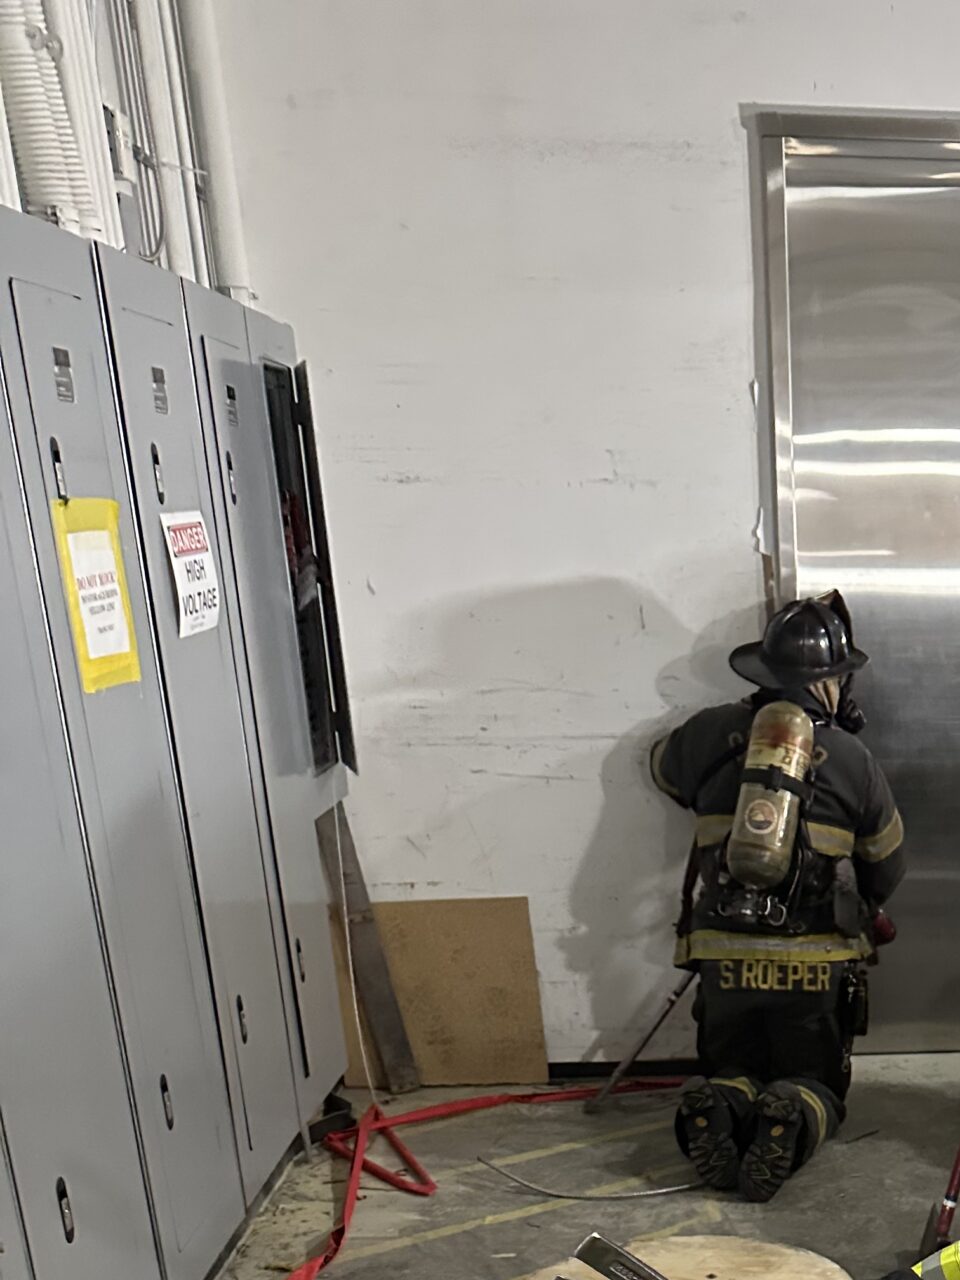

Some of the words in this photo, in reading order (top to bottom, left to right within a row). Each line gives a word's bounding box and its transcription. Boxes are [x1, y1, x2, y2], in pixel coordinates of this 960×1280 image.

[170, 527, 206, 551] DANGER
[185, 558, 206, 582] HIGH
[182, 587, 217, 616] VOLTAGE
[741, 960, 832, 991] ROEPER
